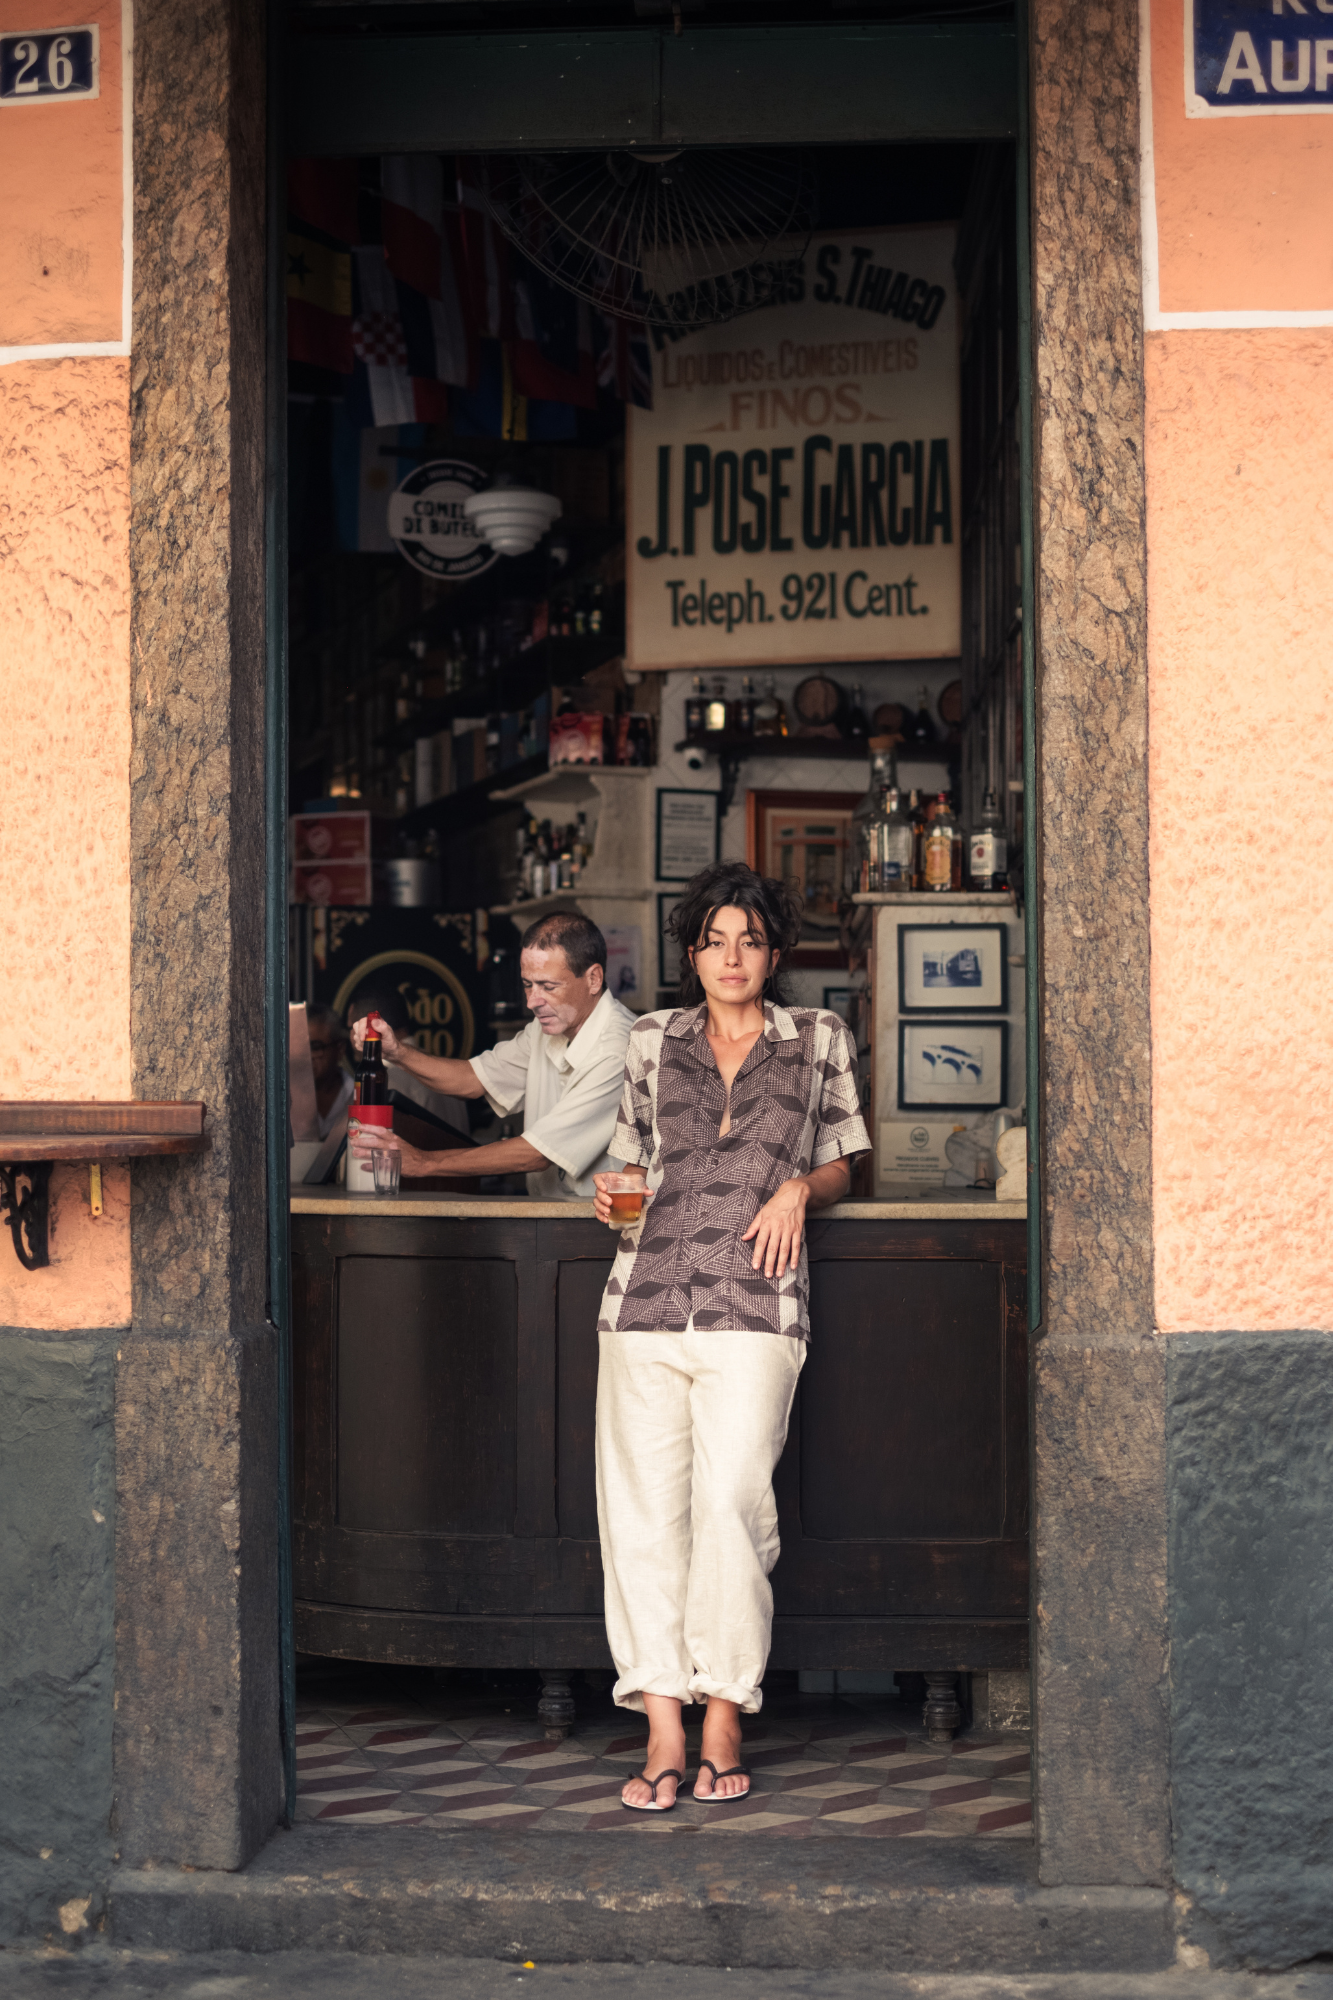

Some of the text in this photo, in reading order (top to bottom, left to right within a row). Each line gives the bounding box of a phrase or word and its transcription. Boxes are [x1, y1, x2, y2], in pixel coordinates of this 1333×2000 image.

[14, 37, 73, 93] 26
[728, 383, 863, 432] FINOS
[802, 435, 954, 550] GARCIA
[665, 570, 929, 633] Teleph. 921 Cent.
